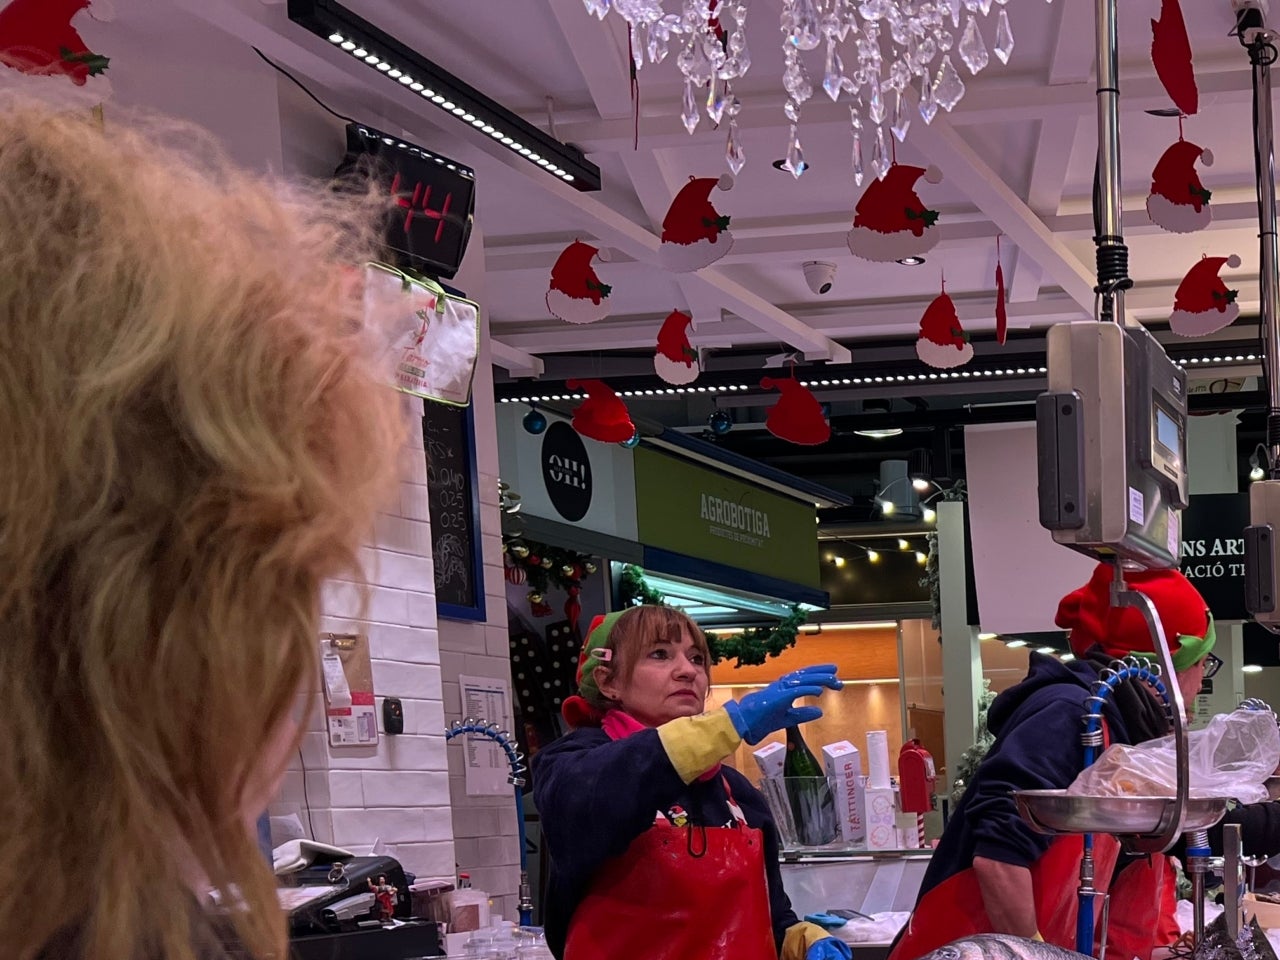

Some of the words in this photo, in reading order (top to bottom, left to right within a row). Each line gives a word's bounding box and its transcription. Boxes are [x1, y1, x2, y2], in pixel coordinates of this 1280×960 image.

[390, 171, 452, 243] 44
[549, 454, 586, 490] OH!
[701, 493, 771, 538] AGROBOTIGA
[1181, 539, 1207, 557] NS
[1209, 538, 1245, 556] ART
[1178, 561, 1225, 578] ACIÓ
[844, 762, 861, 833] TAITTINGER
